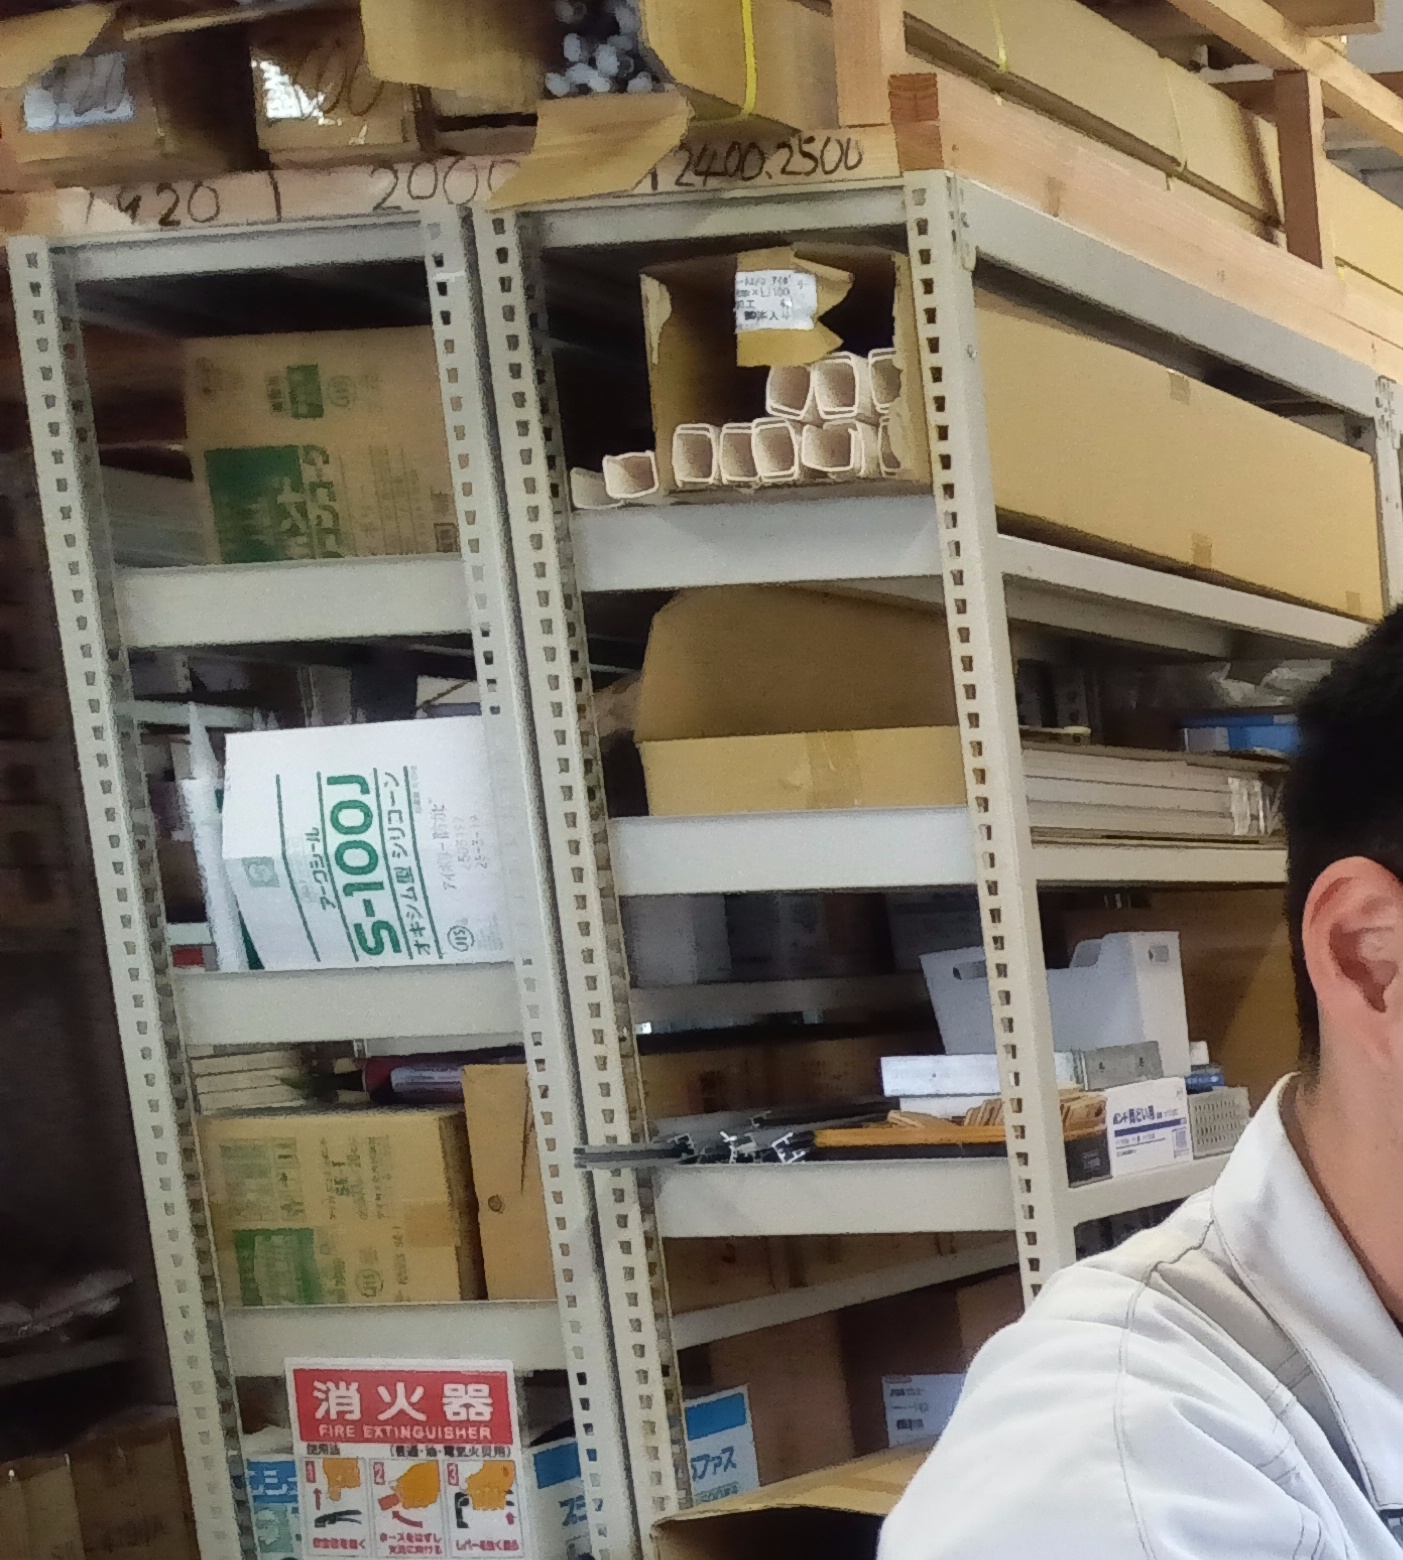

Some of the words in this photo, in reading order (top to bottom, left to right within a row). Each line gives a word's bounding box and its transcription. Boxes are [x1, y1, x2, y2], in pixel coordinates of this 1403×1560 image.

[326, 774, 403, 956] S-100J
[312, 1379, 494, 1423] 消火器
[318, 1425, 355, 1438] FIRE
[363, 1425, 492, 1440] EXTINGUISHER
